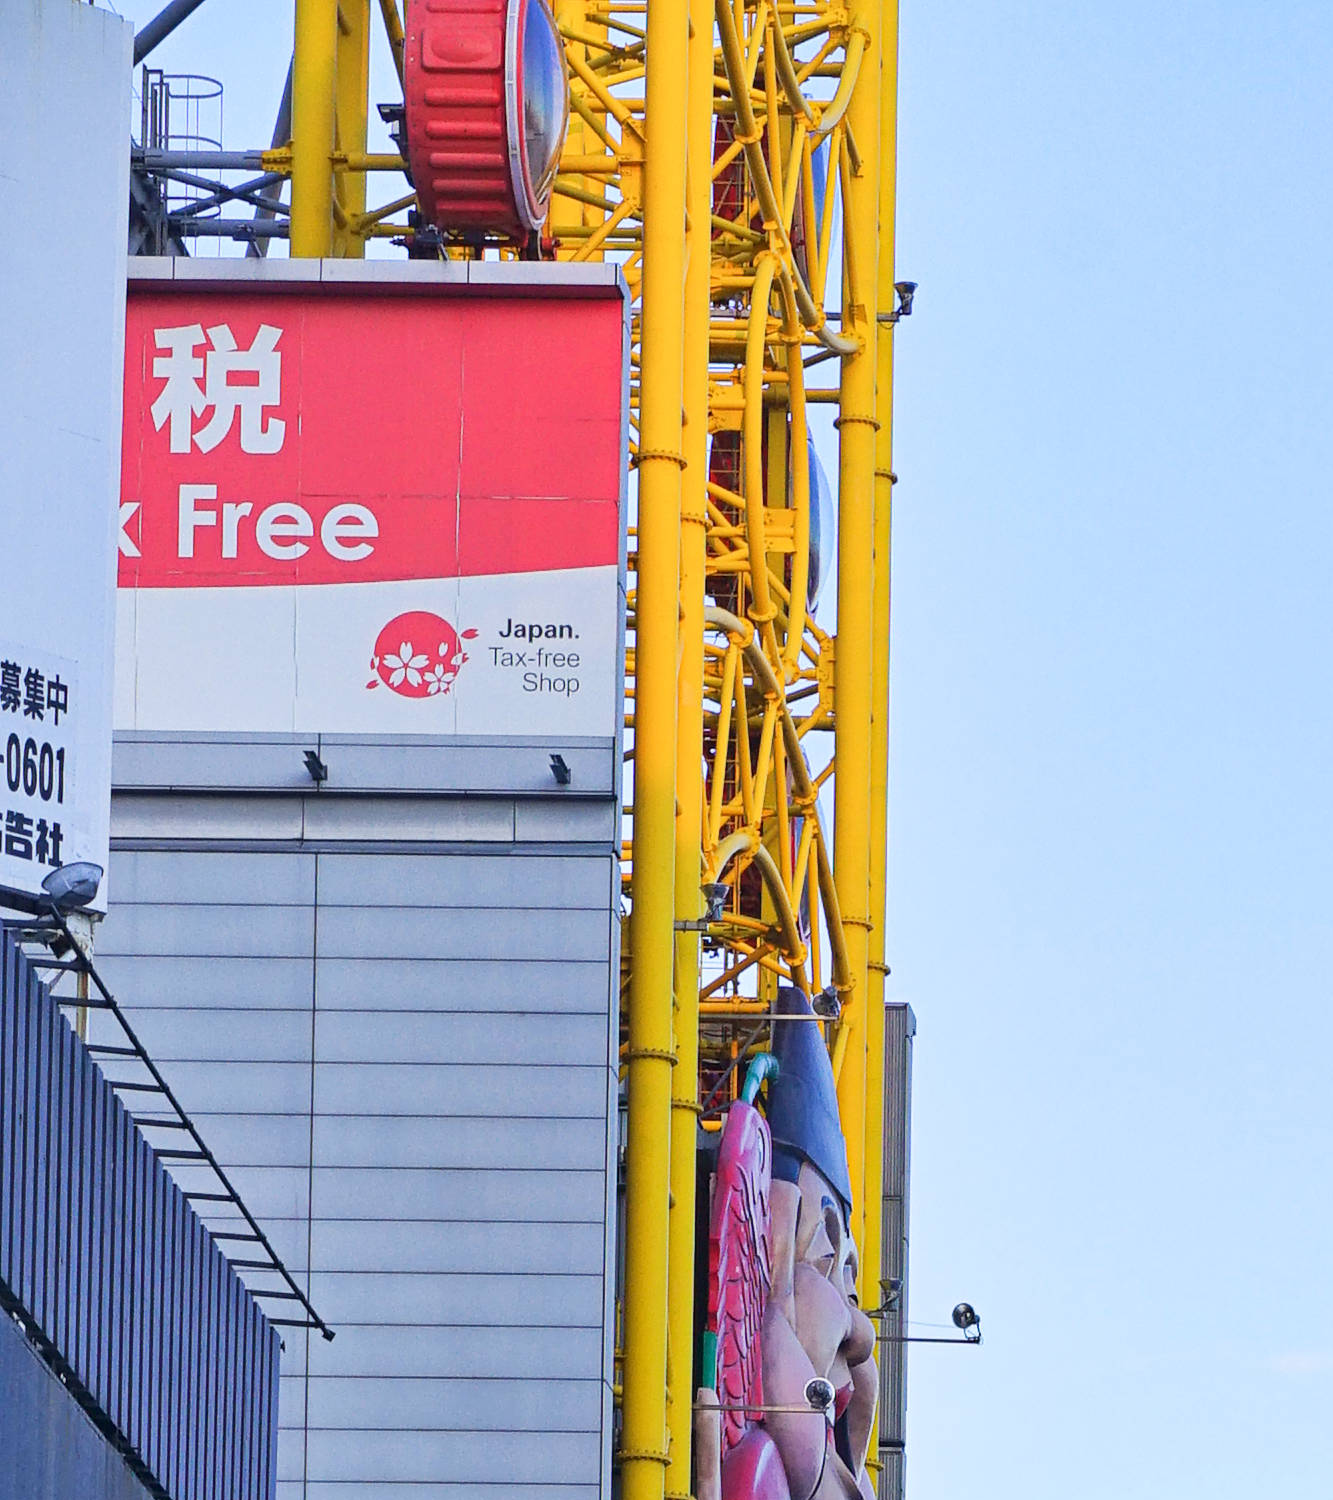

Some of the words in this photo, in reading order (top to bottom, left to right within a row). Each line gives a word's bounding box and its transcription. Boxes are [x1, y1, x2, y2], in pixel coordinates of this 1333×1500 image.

[178, 484, 381, 562] Free
[498, 619, 580, 644] Japan.
[488, 647, 581, 670] Tax-free
[522, 673, 580, 698] Shop
[0, 808, 64, 869] 告社
